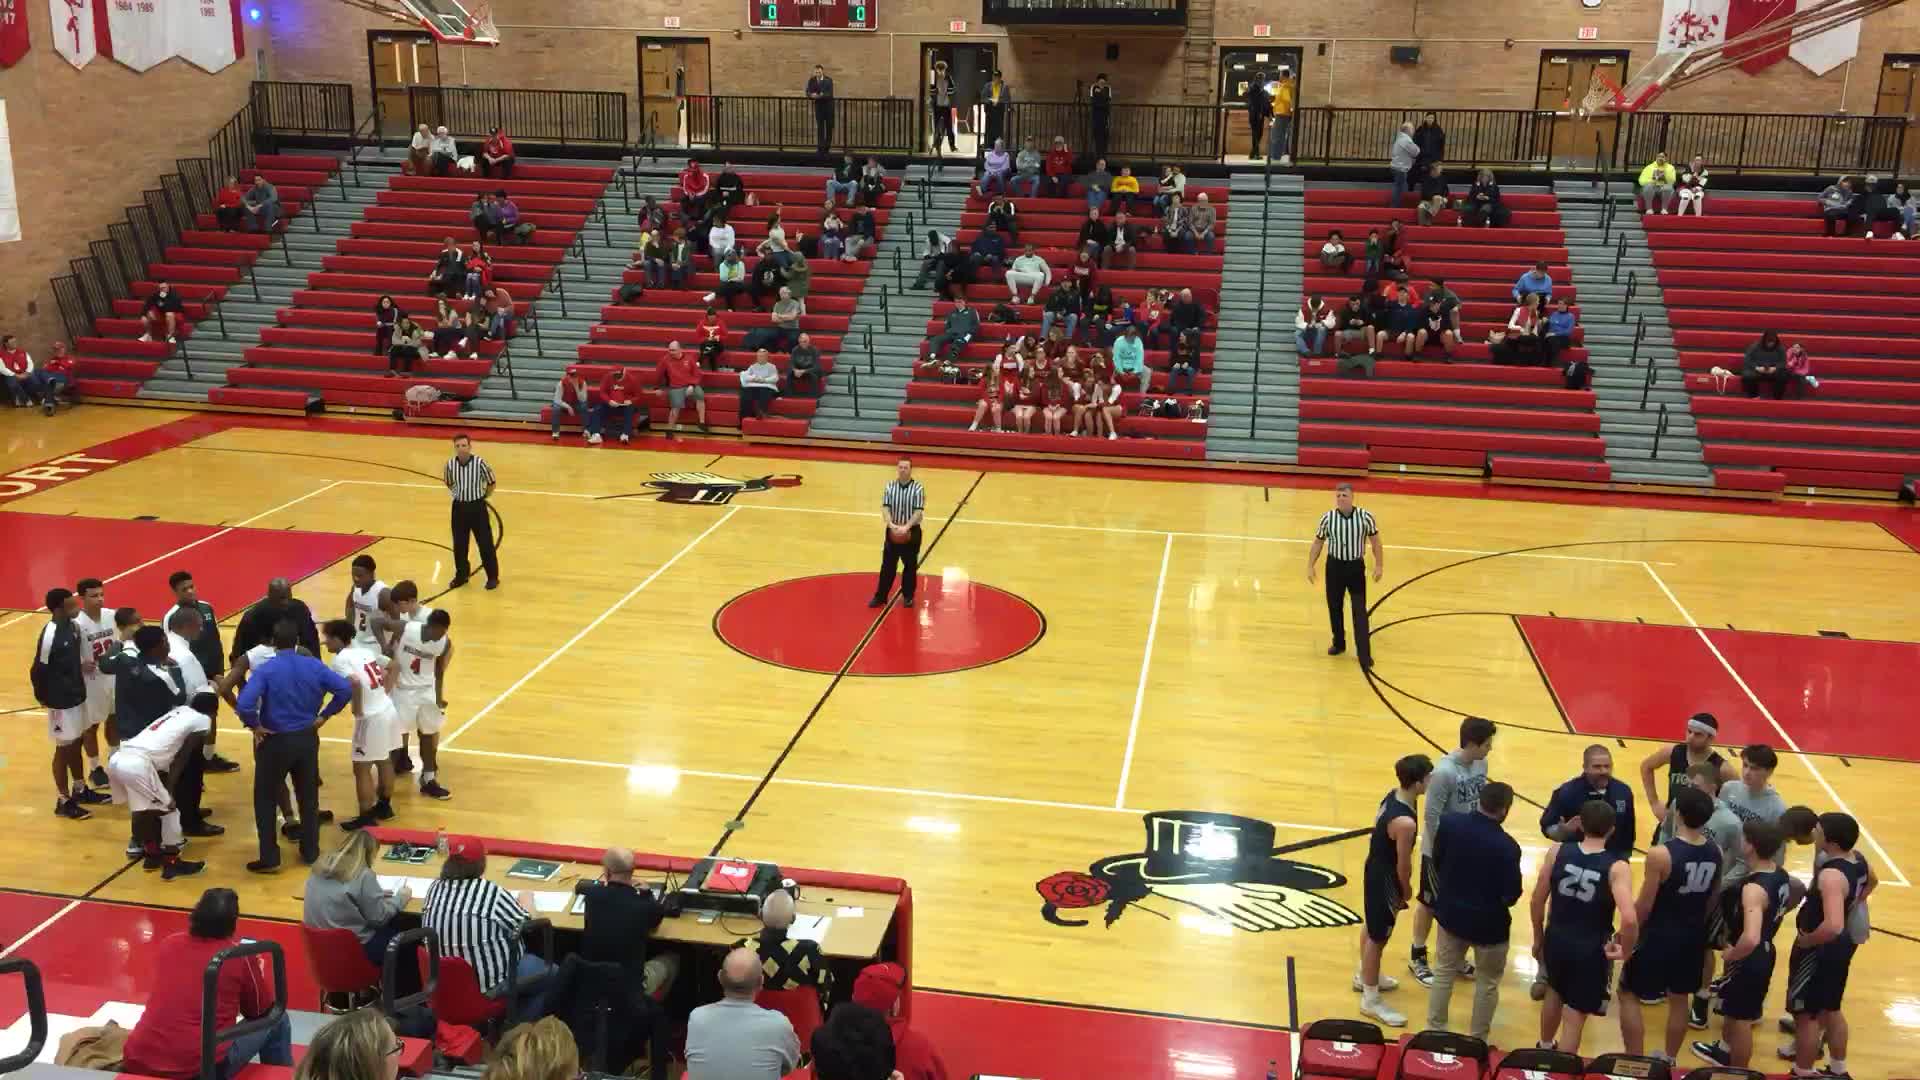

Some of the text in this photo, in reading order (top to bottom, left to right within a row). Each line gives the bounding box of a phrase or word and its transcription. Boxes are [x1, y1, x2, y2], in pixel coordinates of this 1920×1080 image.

[768, 4, 777, 20] 0
[856, 6, 866, 21] 0
[410, 657, 421, 675] 4
[1557, 863, 1601, 903] 25
